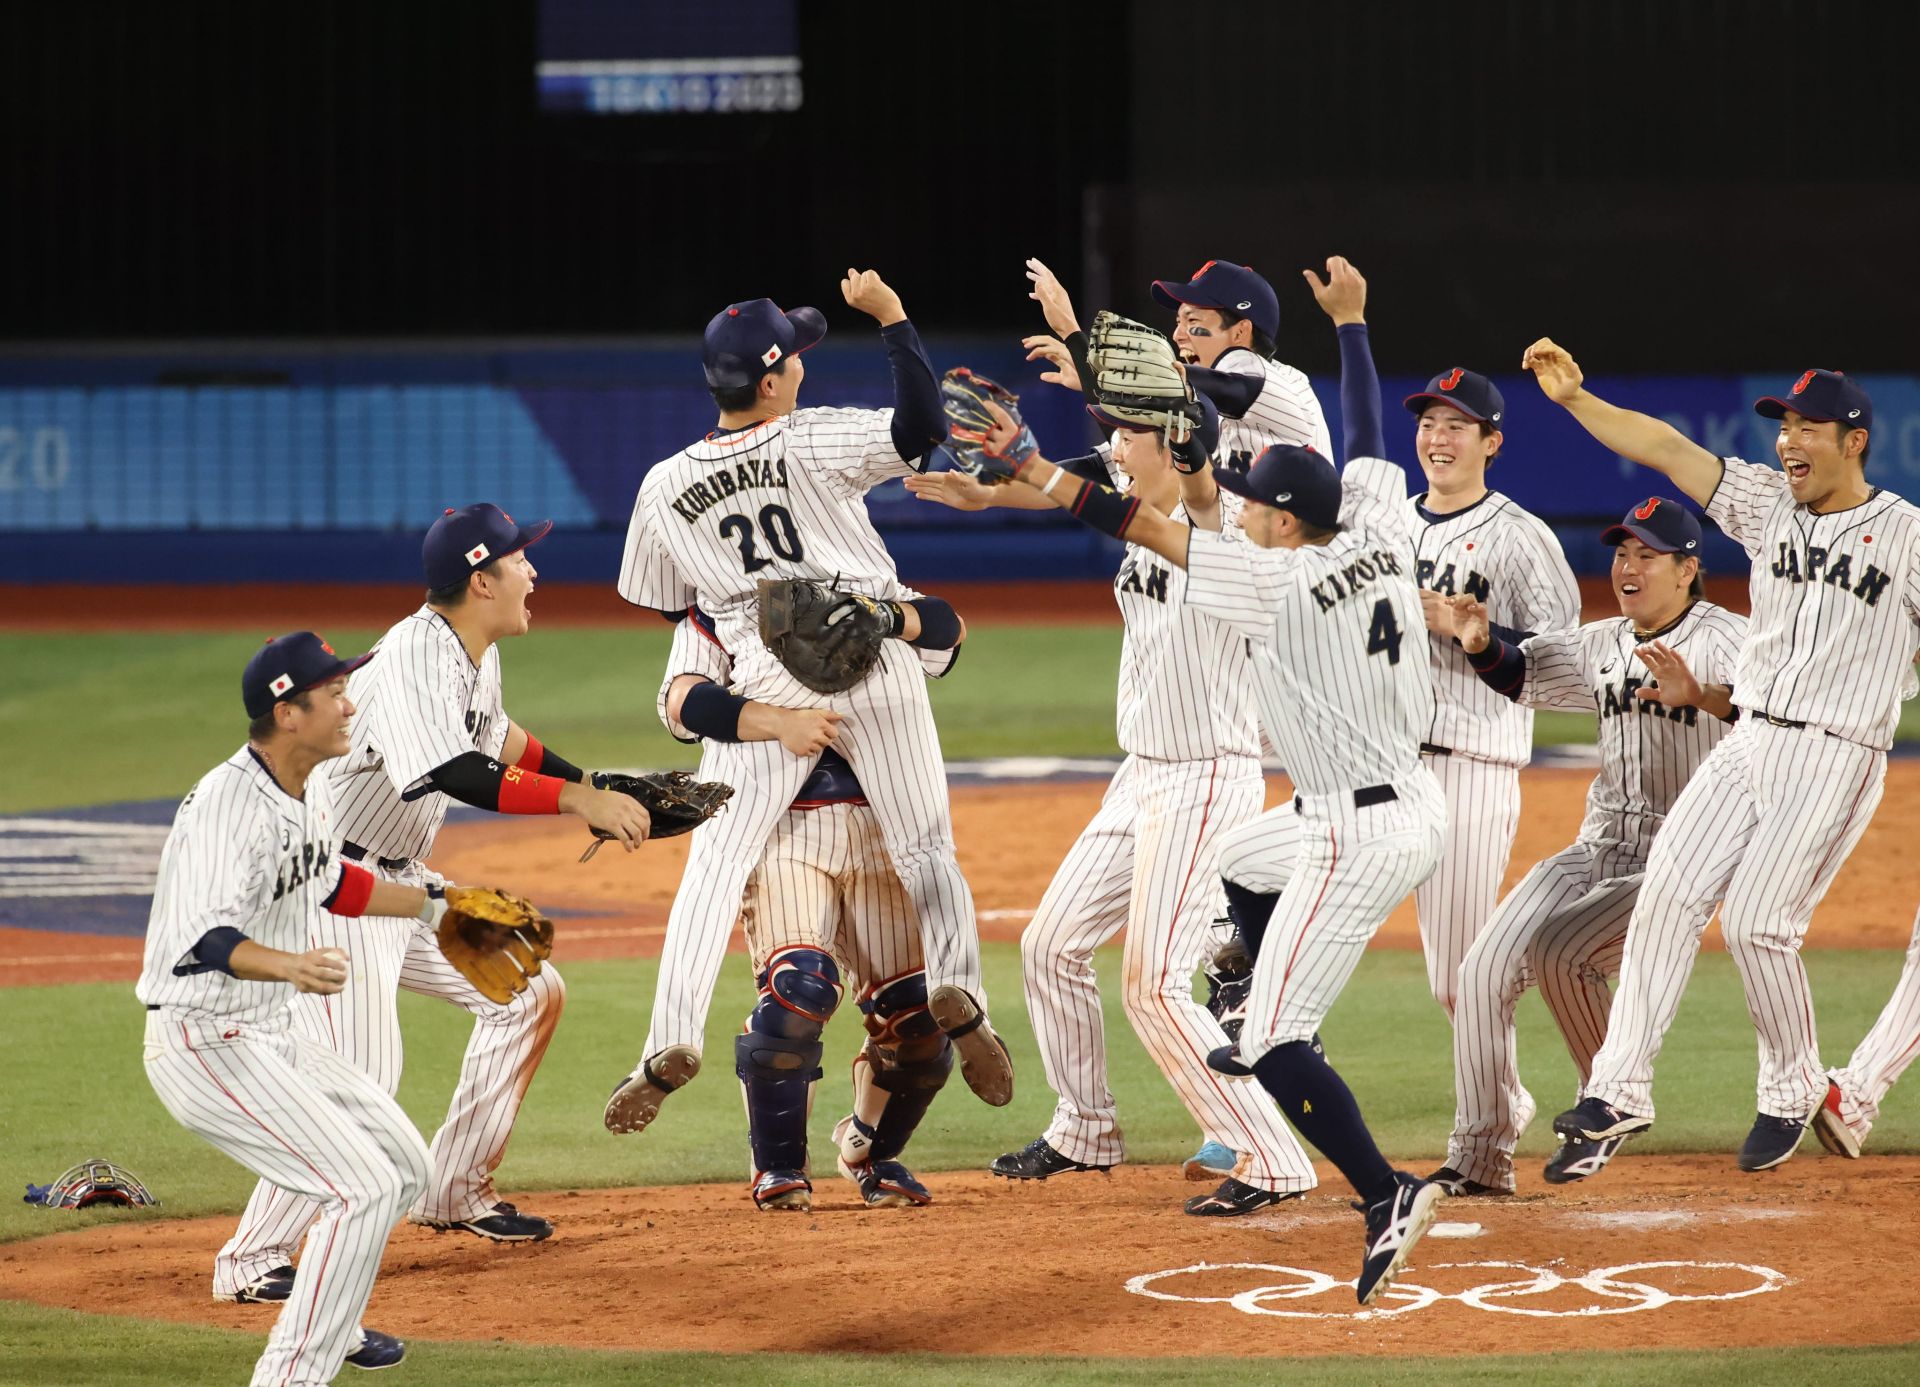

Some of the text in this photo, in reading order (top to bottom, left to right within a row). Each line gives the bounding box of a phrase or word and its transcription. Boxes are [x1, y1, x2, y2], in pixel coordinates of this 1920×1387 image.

[719, 503, 804, 574] 20
[1771, 542, 1891, 608] JAPAN
[1367, 598, 1404, 666] 4
